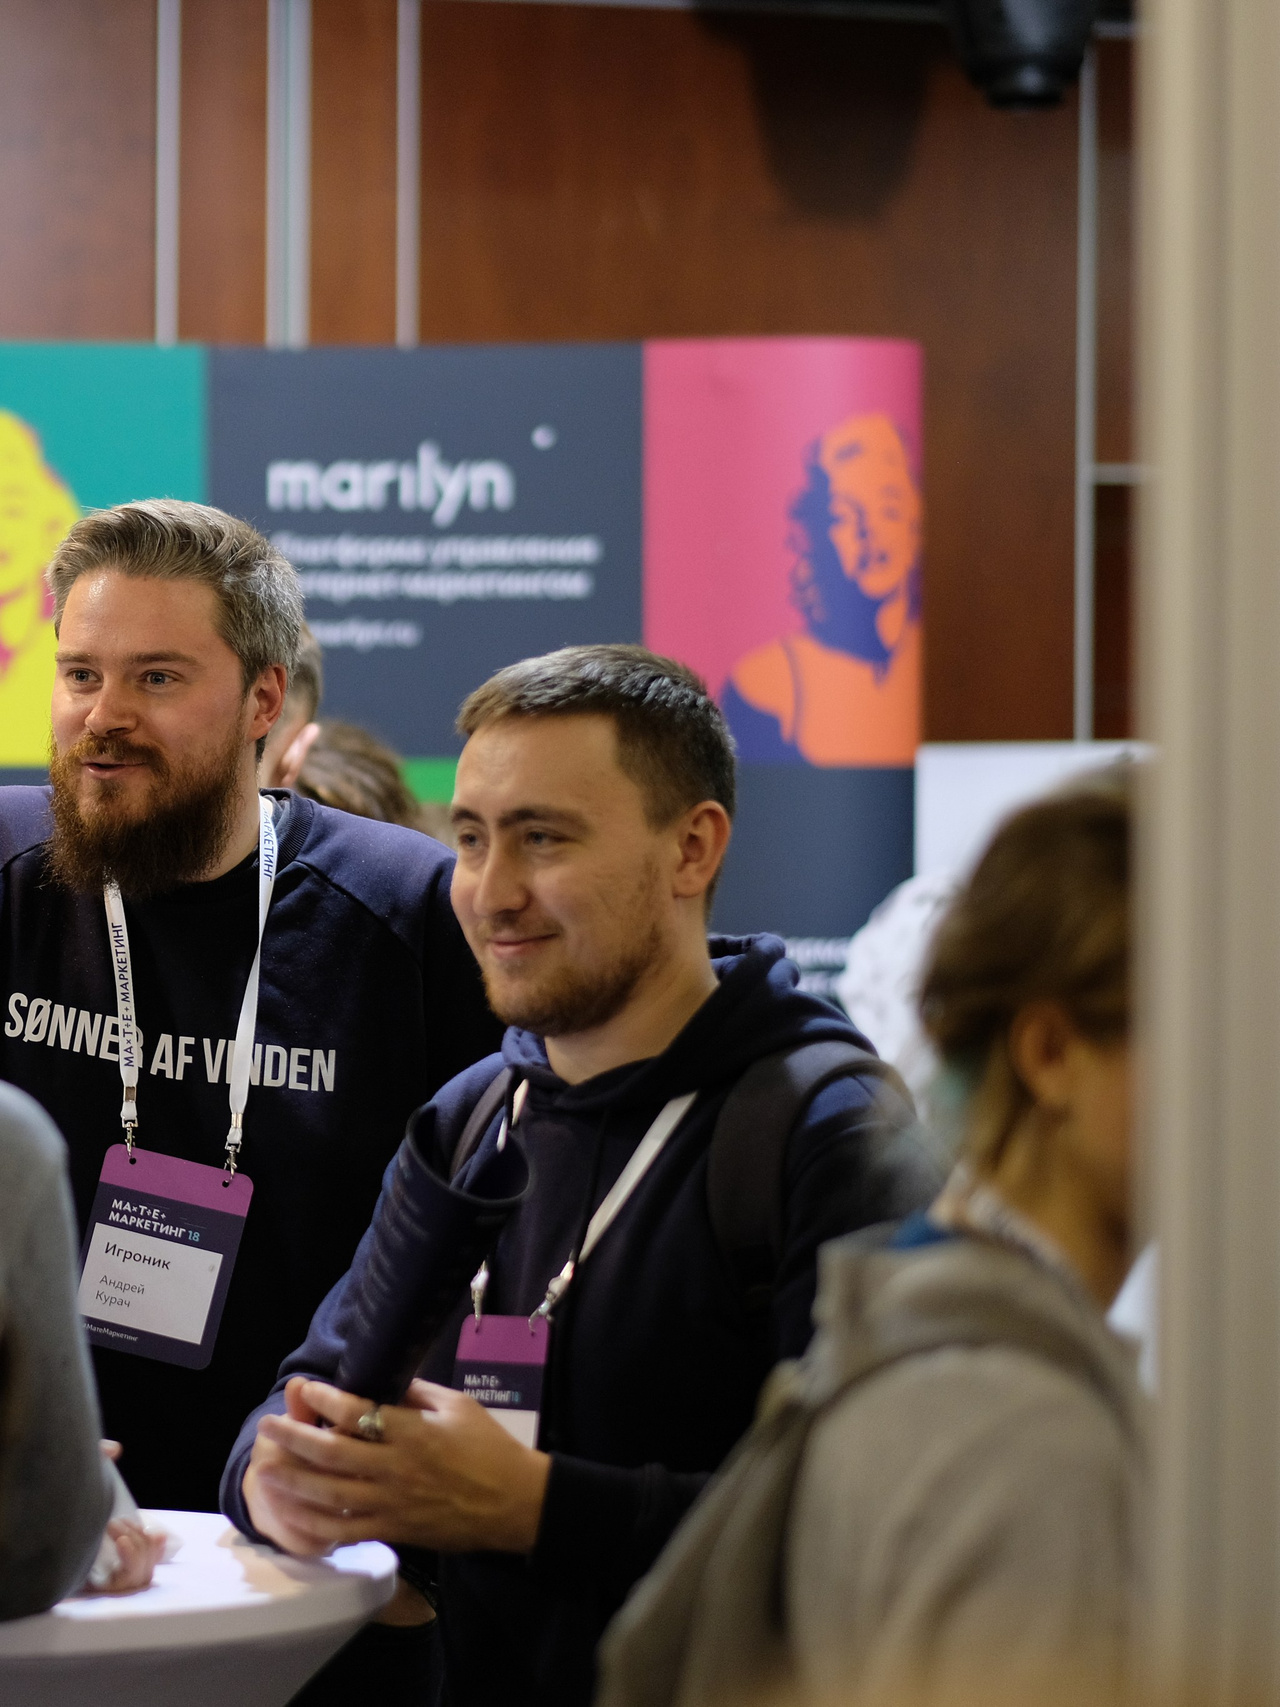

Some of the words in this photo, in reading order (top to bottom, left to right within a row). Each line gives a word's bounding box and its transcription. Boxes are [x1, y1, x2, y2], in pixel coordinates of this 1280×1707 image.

[266, 440, 516, 528] marilyn
[111, 922, 131, 1003] МАРКЕТИНГ
[150, 1033, 195, 1081] AF
[108, 1211, 186, 1238] МАРКЕТИНГ
[187, 1230, 201, 1242] 18
[104, 1241, 171, 1270] Игроник
[95, 1290, 131, 1308] Курач
[99, 1274, 145, 1295] Андрей
